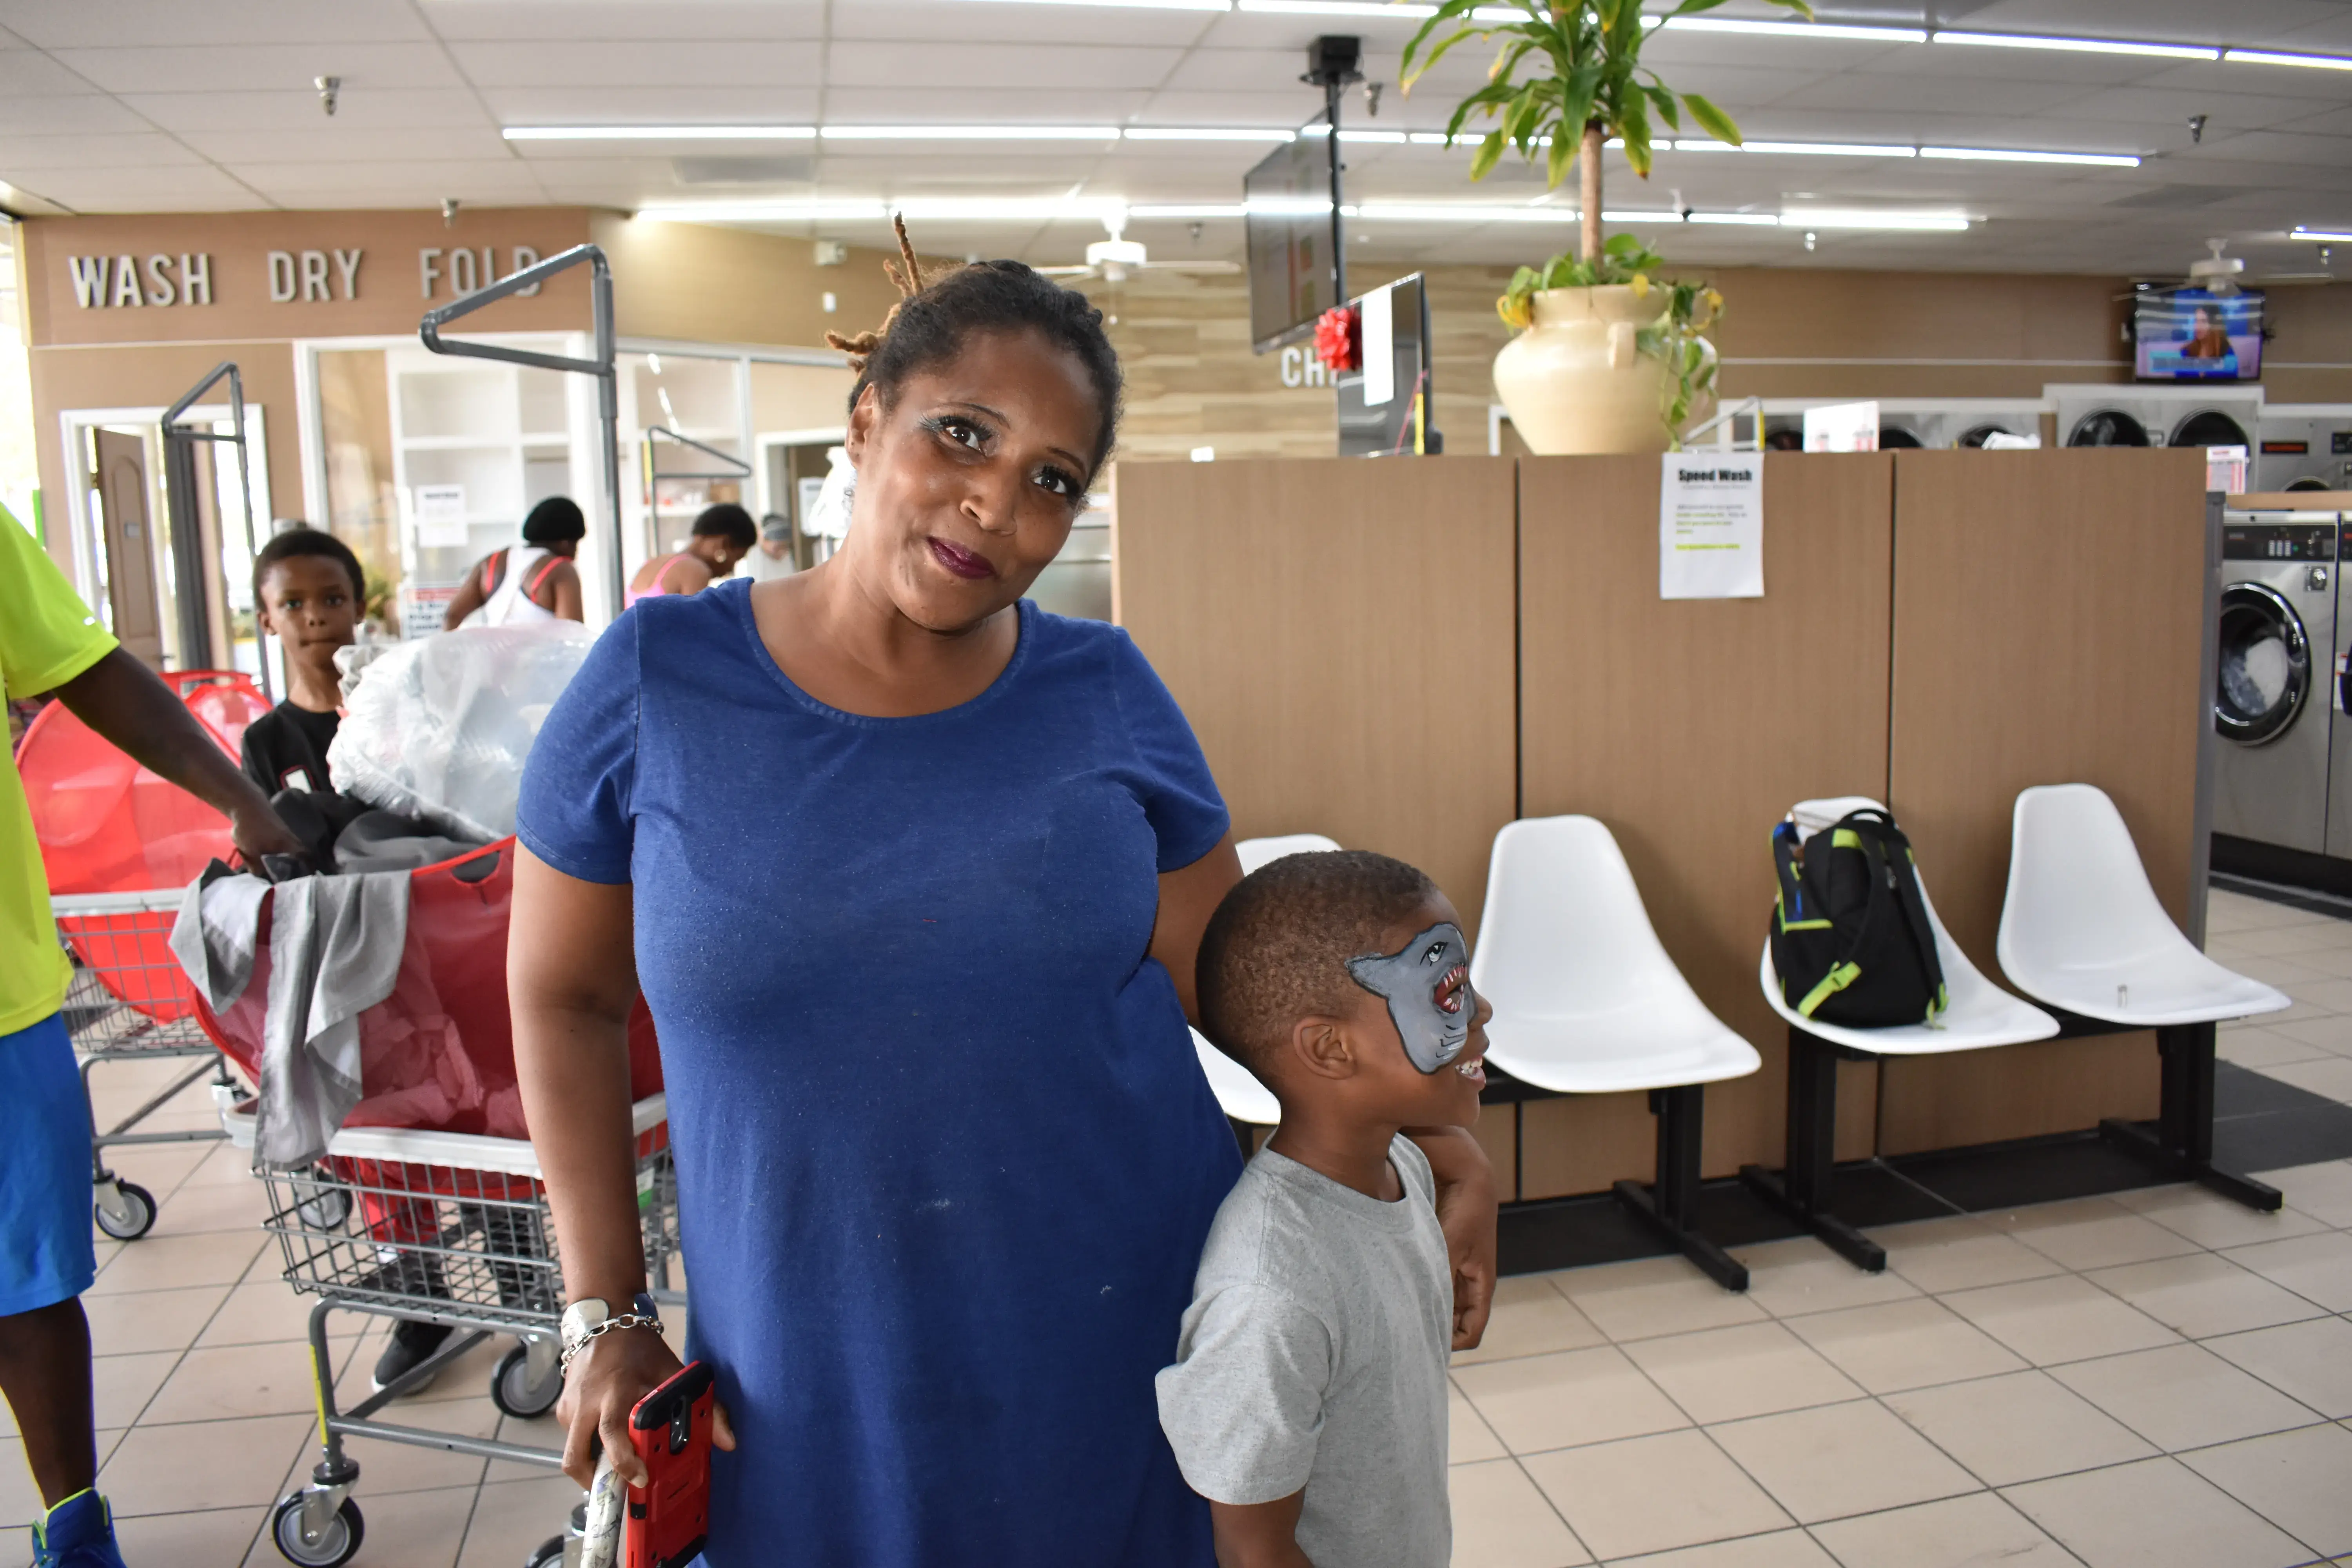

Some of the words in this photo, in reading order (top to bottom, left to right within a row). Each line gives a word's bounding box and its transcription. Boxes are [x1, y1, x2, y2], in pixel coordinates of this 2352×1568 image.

[69, 253, 211, 309] WASH
[267, 249, 362, 302] DRY
[1679, 468, 1716, 483] Speed
[1718, 468, 1752, 481] Wash
